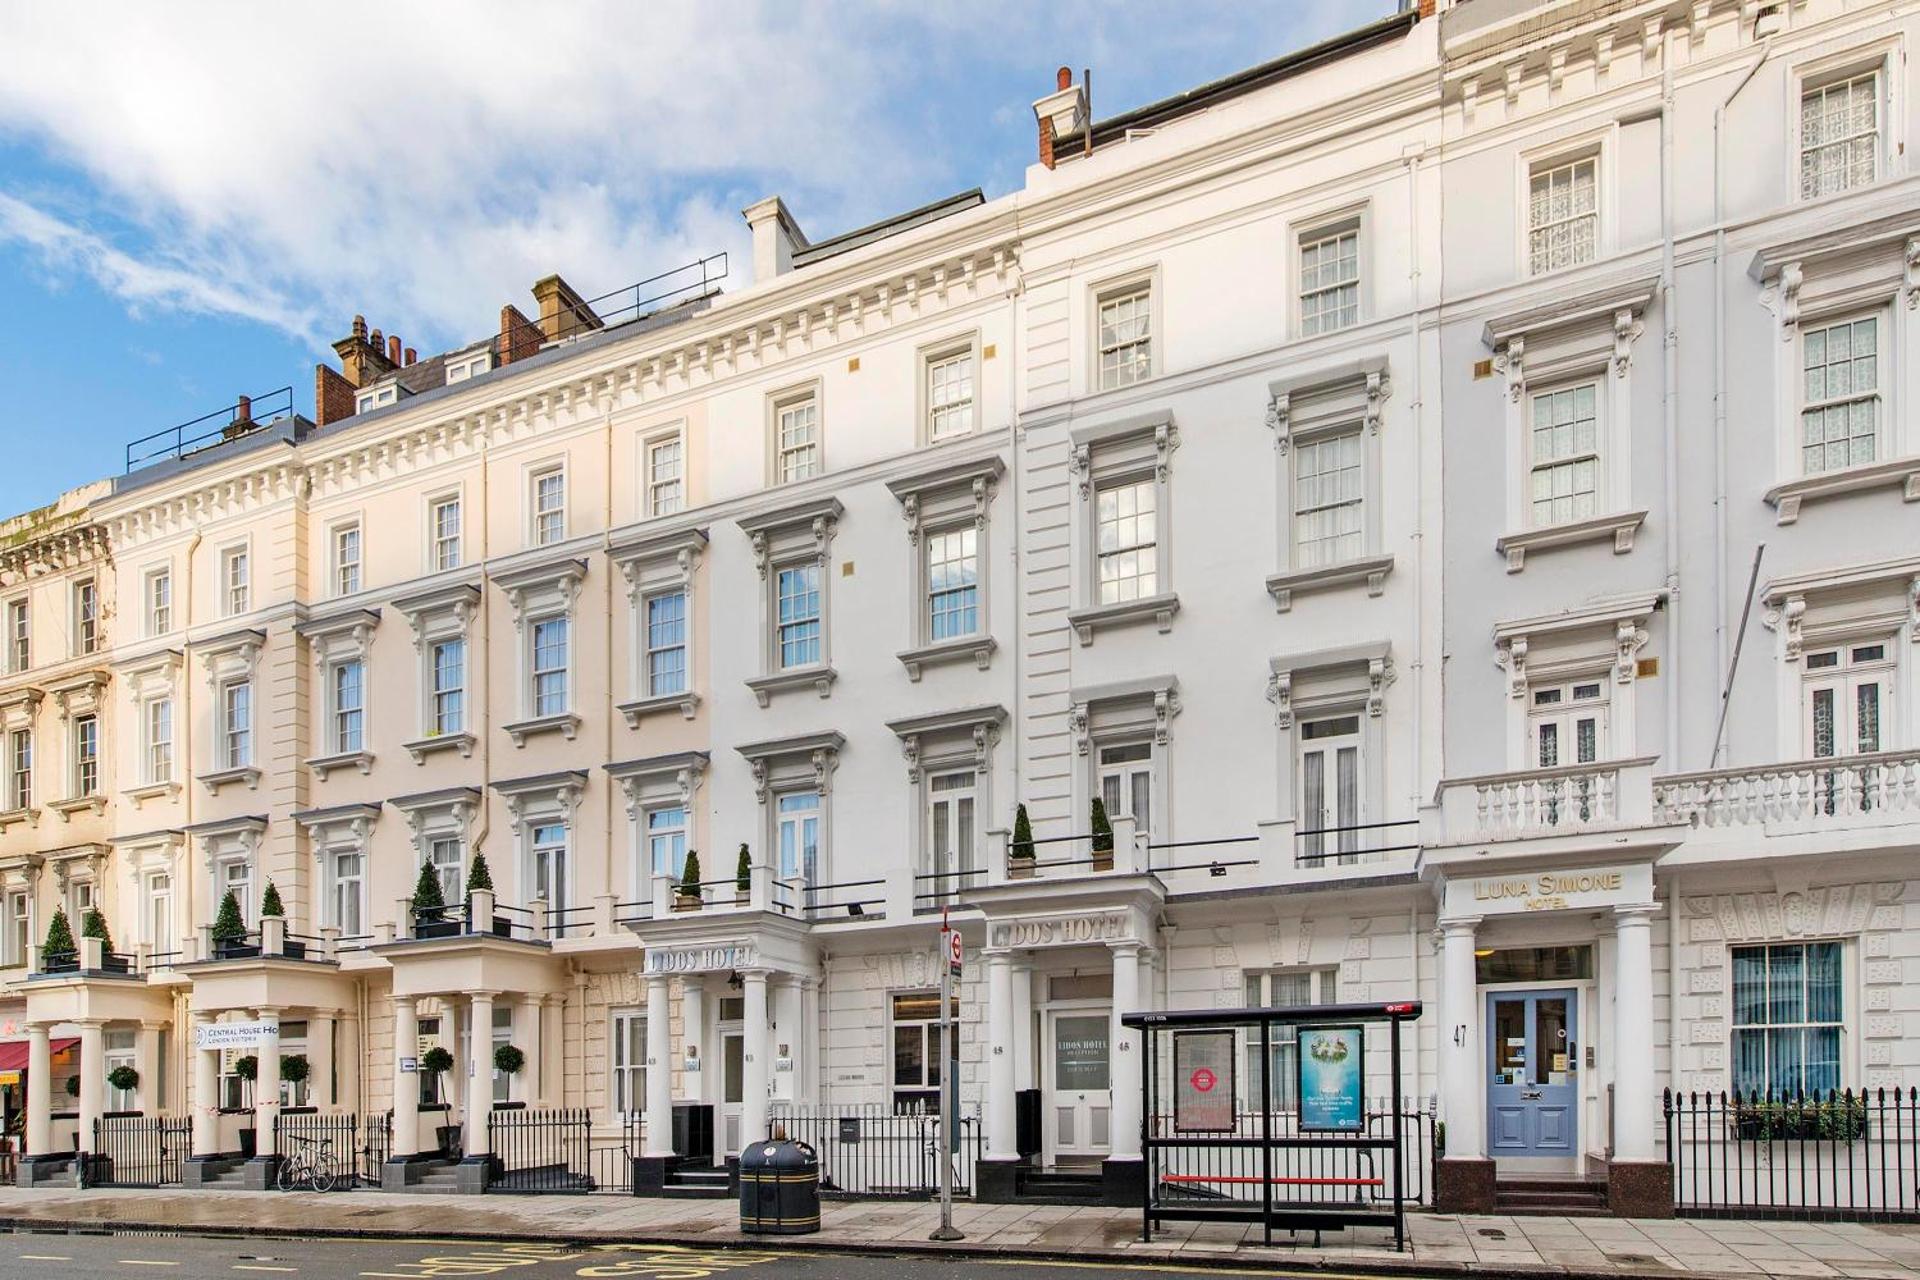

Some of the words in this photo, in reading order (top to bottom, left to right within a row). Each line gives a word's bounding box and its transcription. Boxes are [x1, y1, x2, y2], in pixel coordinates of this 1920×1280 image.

[1474, 879, 1531, 901] LUNA
[1537, 873, 1622, 896] SIMONE
[1524, 897, 1568, 911] HOTEL
[1060, 914, 1129, 942] HOTEL
[702, 945, 758, 970] HOTEL
[1453, 1024, 1467, 1048] 47
